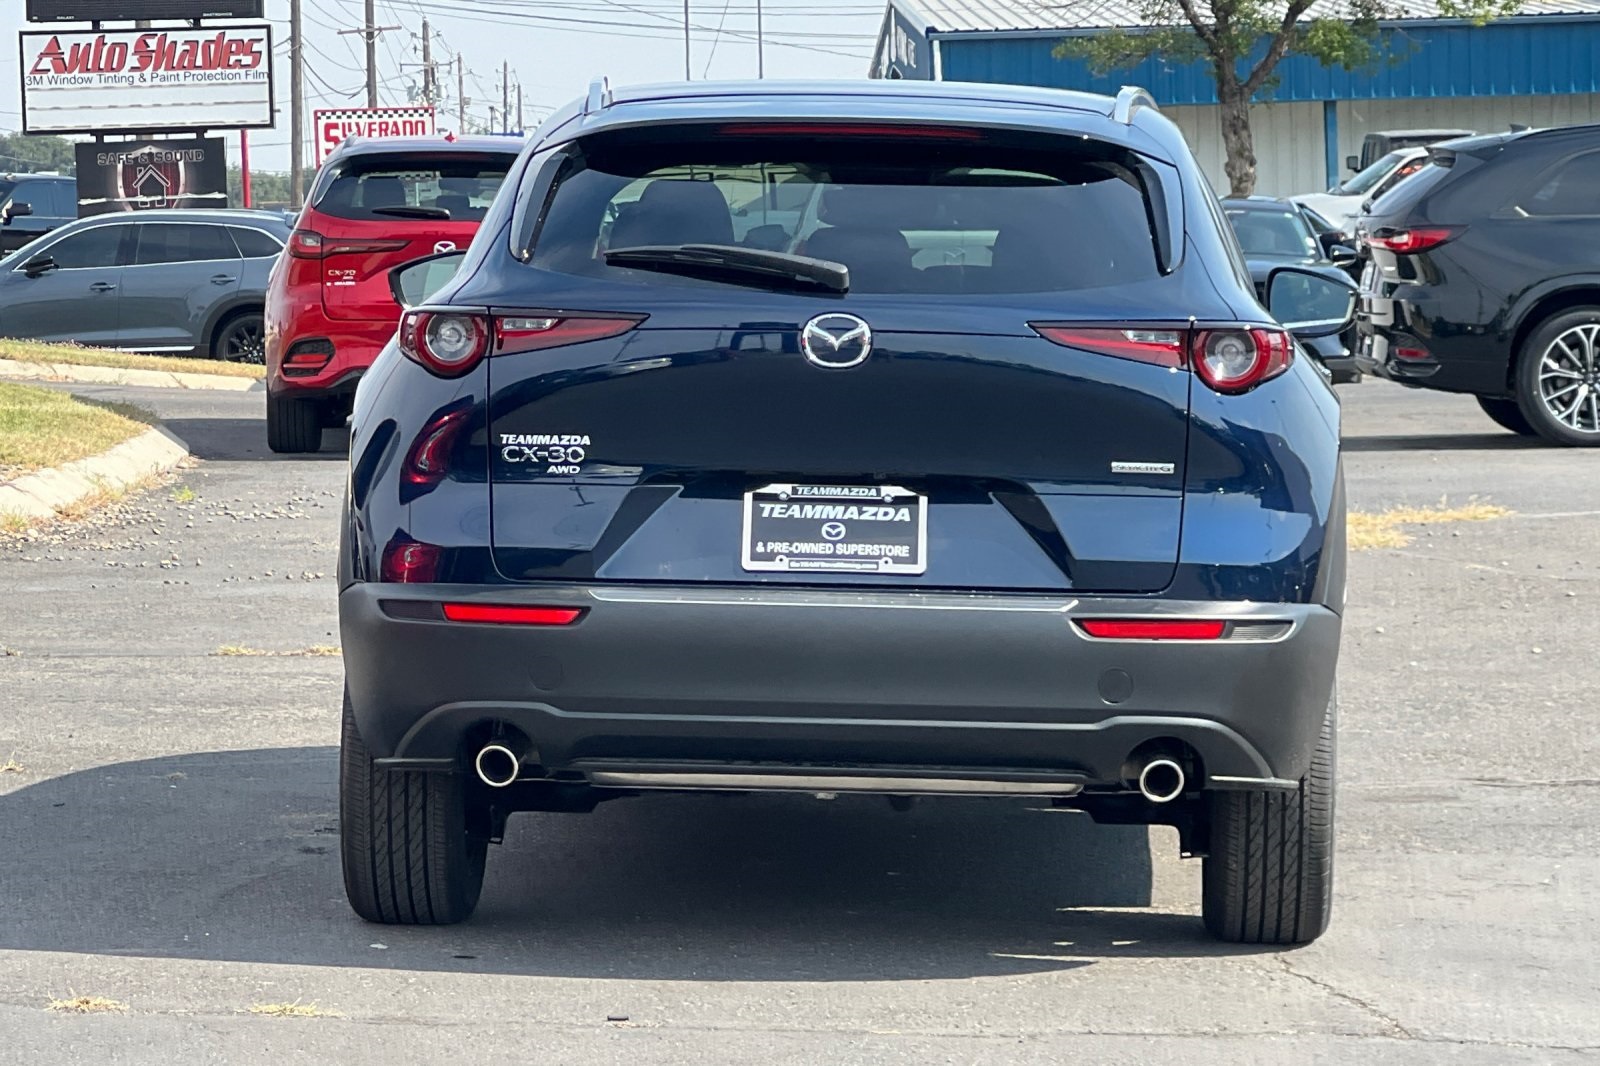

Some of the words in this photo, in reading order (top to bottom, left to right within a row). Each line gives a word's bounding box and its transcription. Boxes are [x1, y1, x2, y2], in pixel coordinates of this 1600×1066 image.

[26, 76, 43, 86] 3M
[47, 75, 93, 85] Window
[96, 73, 134, 86] Tinting
[138, 73, 147, 82] &
[151, 72, 180, 82] Paint
[184, 70, 241, 81] Protection
[245, 70, 269, 80] Film
[97, 152, 133, 166] SAFE
[138, 152, 149, 164] &
[154, 149, 205, 164] SOUND
[500, 434, 591, 445] TEAMMAZDA
[502, 446, 585, 463] CX-30
[547, 465, 580, 474] AWD
[796, 486, 877, 497] TEAMMAZDA
[759, 503, 911, 522] TEAMMAZDA
[756, 542, 765, 553] &
[767, 542, 834, 554] PRE-OWNED
[836, 543, 910, 557] SUPERSTORE
